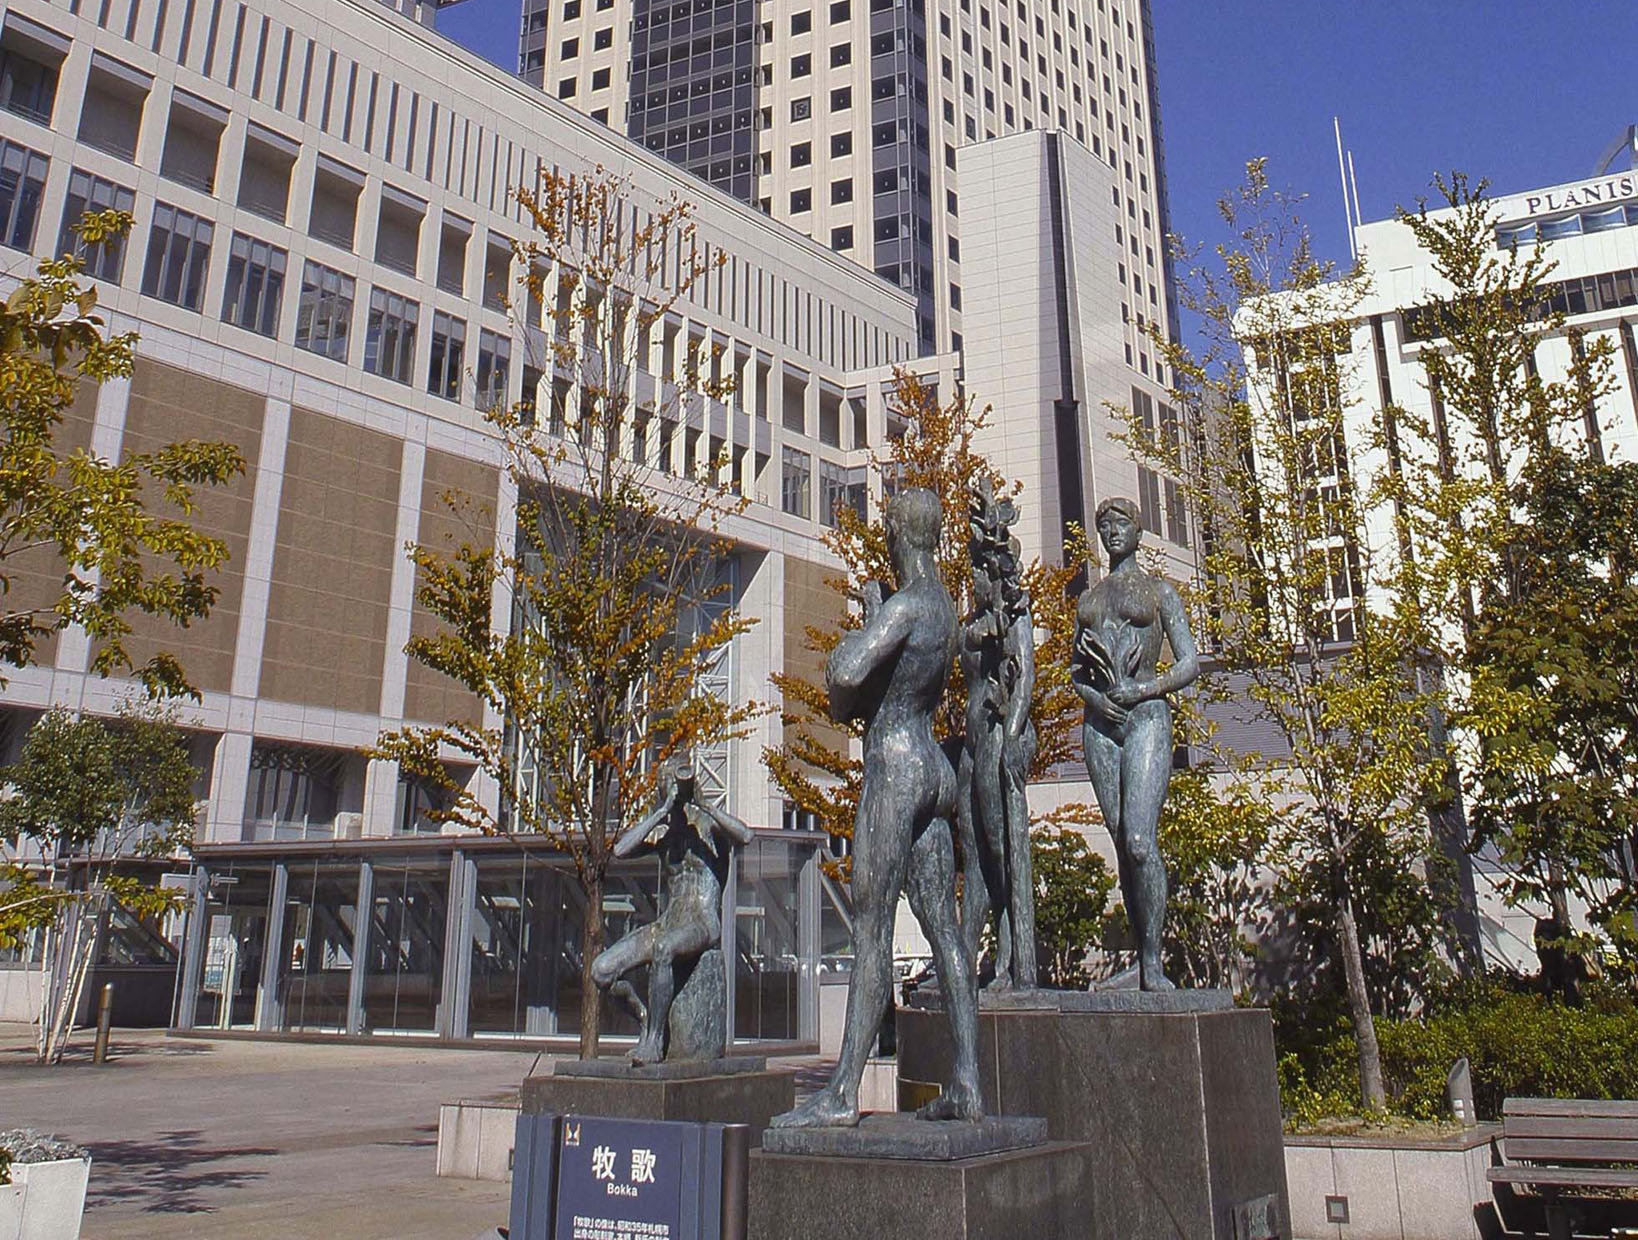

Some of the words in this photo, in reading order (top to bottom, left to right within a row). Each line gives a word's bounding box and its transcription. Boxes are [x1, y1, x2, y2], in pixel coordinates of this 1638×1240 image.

[1526, 178, 1633, 215] PLANIS
[592, 1145, 656, 1183] 牧歌
[607, 1183, 638, 1197] Bokka
